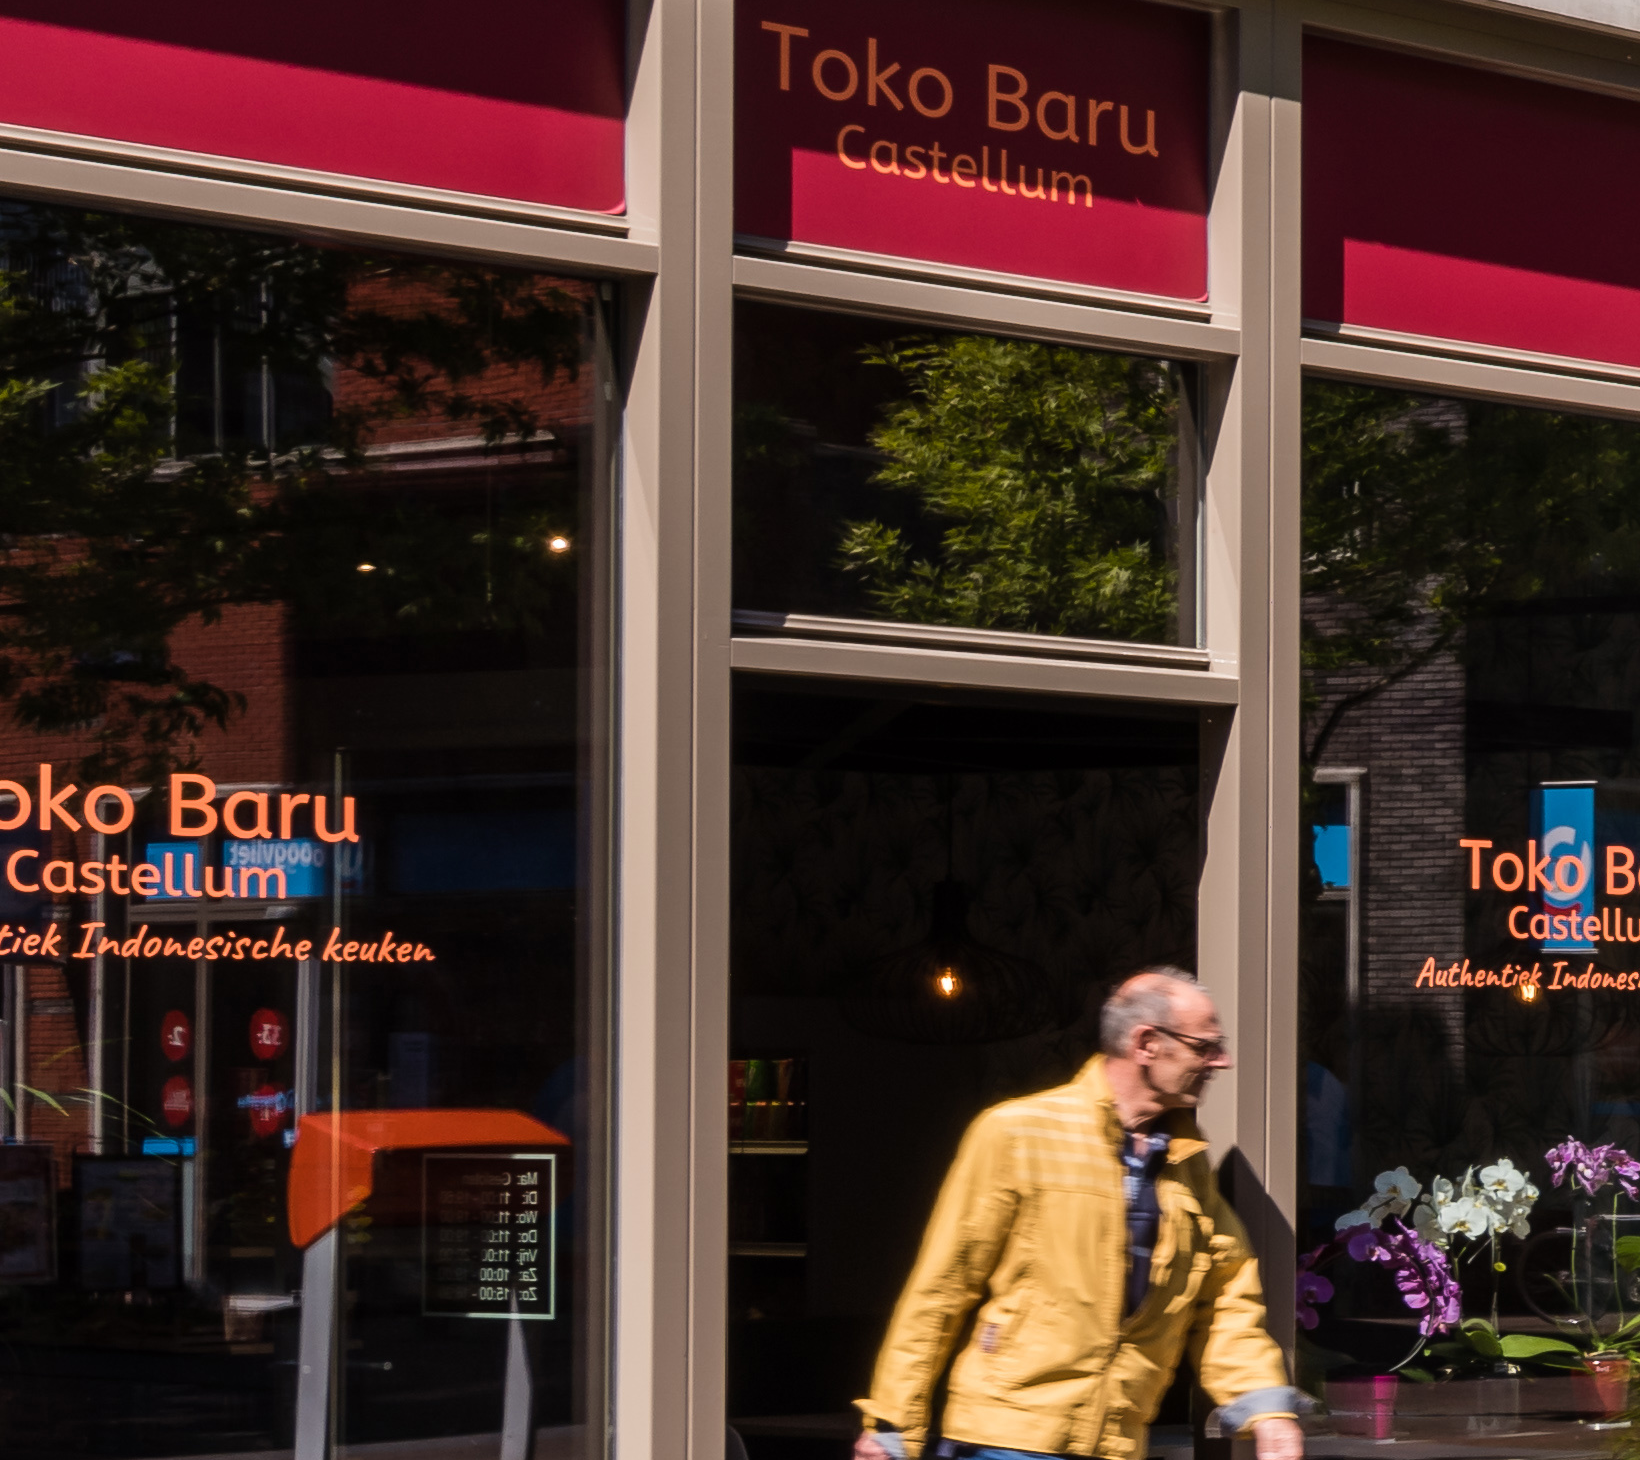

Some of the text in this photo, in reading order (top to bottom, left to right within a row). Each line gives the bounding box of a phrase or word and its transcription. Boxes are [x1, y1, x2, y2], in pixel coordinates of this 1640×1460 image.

[762, 20, 1158, 157] Toko Baru
[837, 125, 1093, 207] Castellum
[0, 764, 360, 843] oko Baru
[6, 850, 287, 899] Castellum
[1459, 839, 1585, 894] Toko
[72, 922, 310, 960] Indonesische
[323, 927, 435, 963] keuken
[1416, 957, 1542, 989] Authentiek
